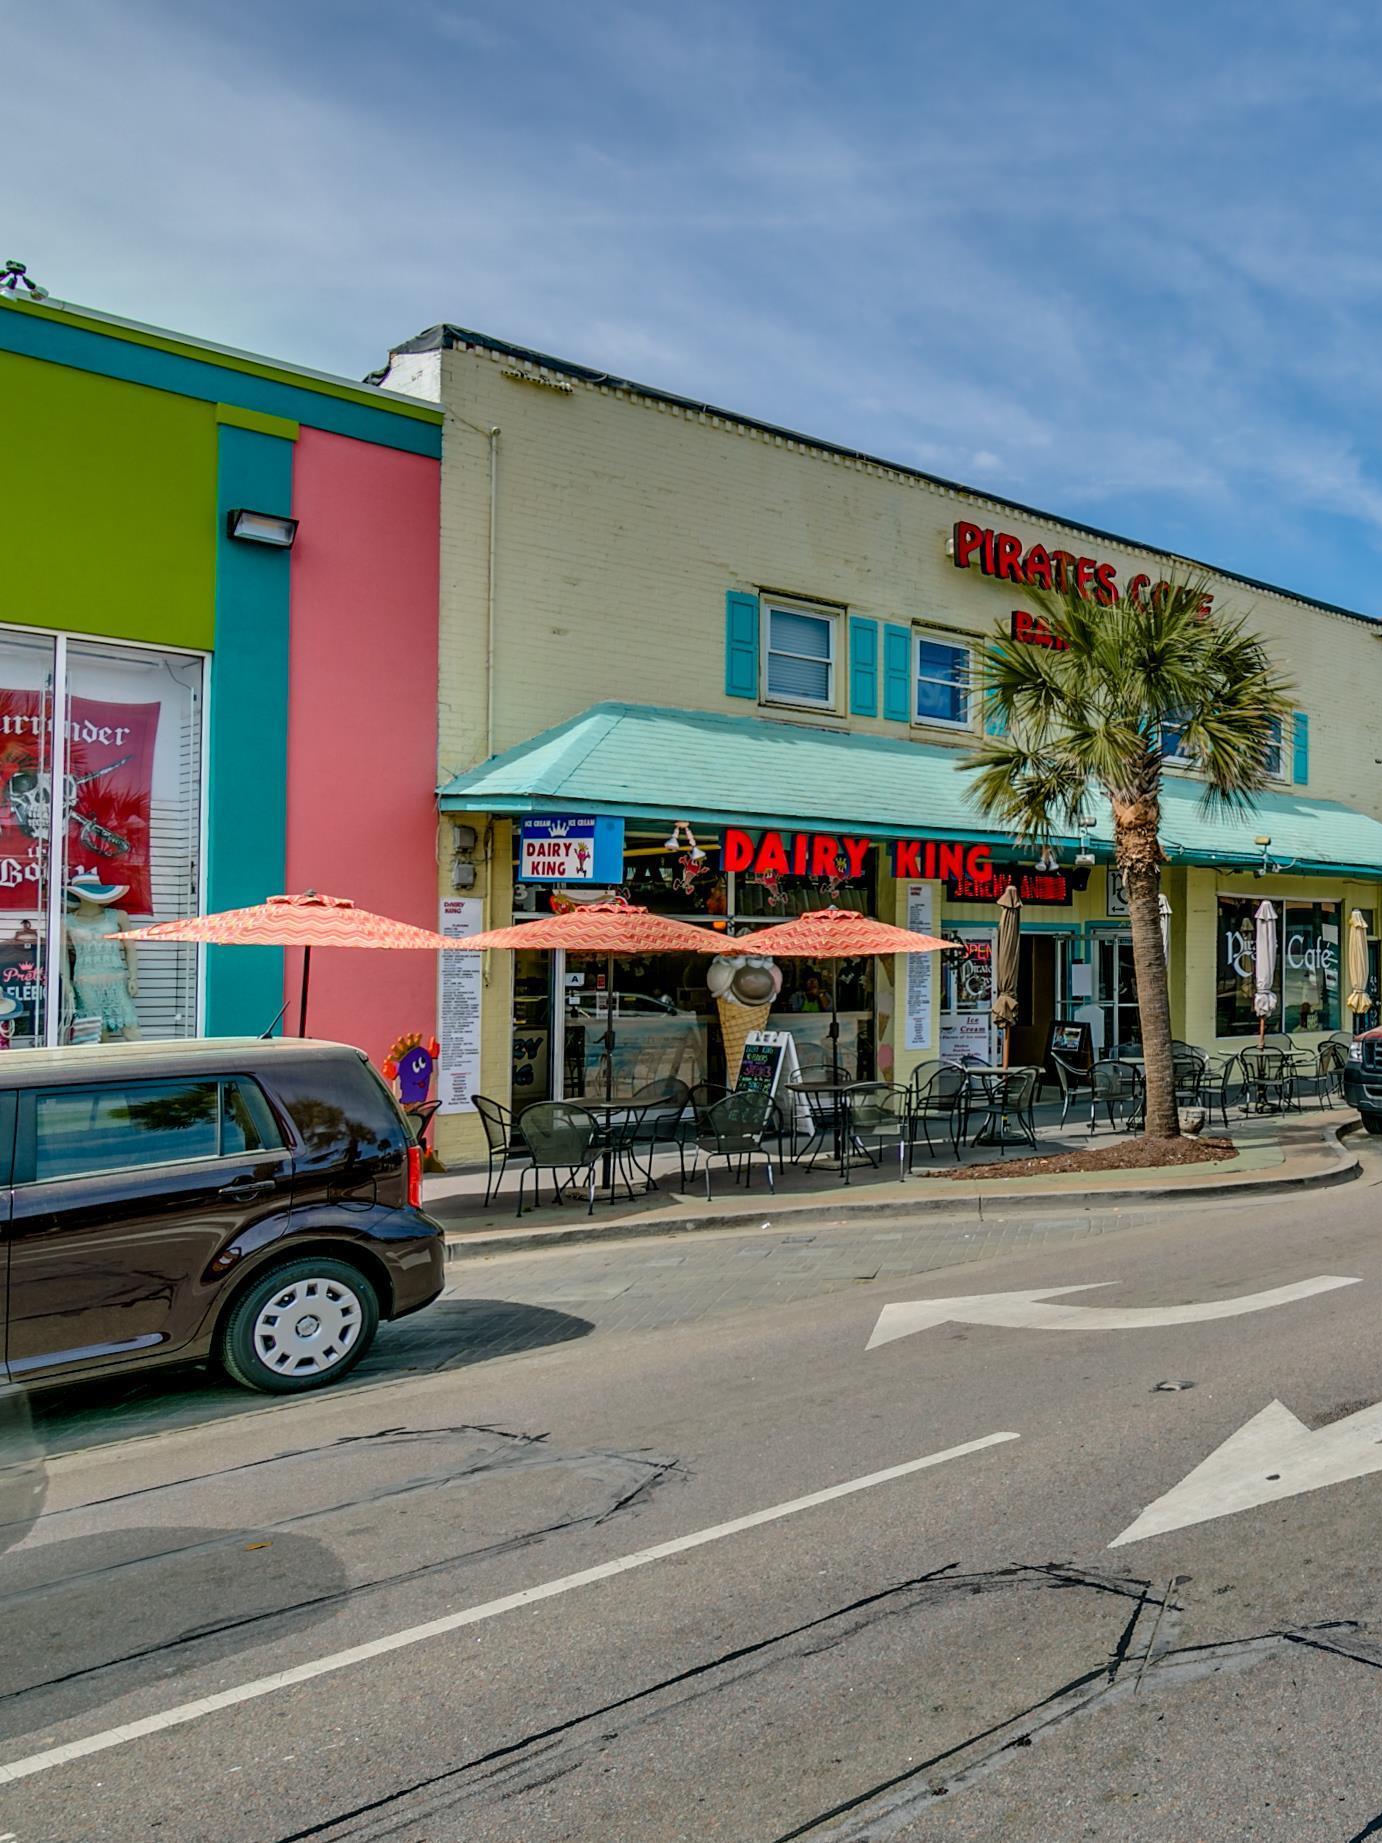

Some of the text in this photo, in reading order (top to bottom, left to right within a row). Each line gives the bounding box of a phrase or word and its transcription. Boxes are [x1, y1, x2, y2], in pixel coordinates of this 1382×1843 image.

[954, 521, 1120, 607] PIRATES
[526, 842, 572, 857] DAIRY
[722, 828, 993, 881] DAIRY KING
[531, 861, 566, 876] KING
[1287, 934, 1332, 969] Café
